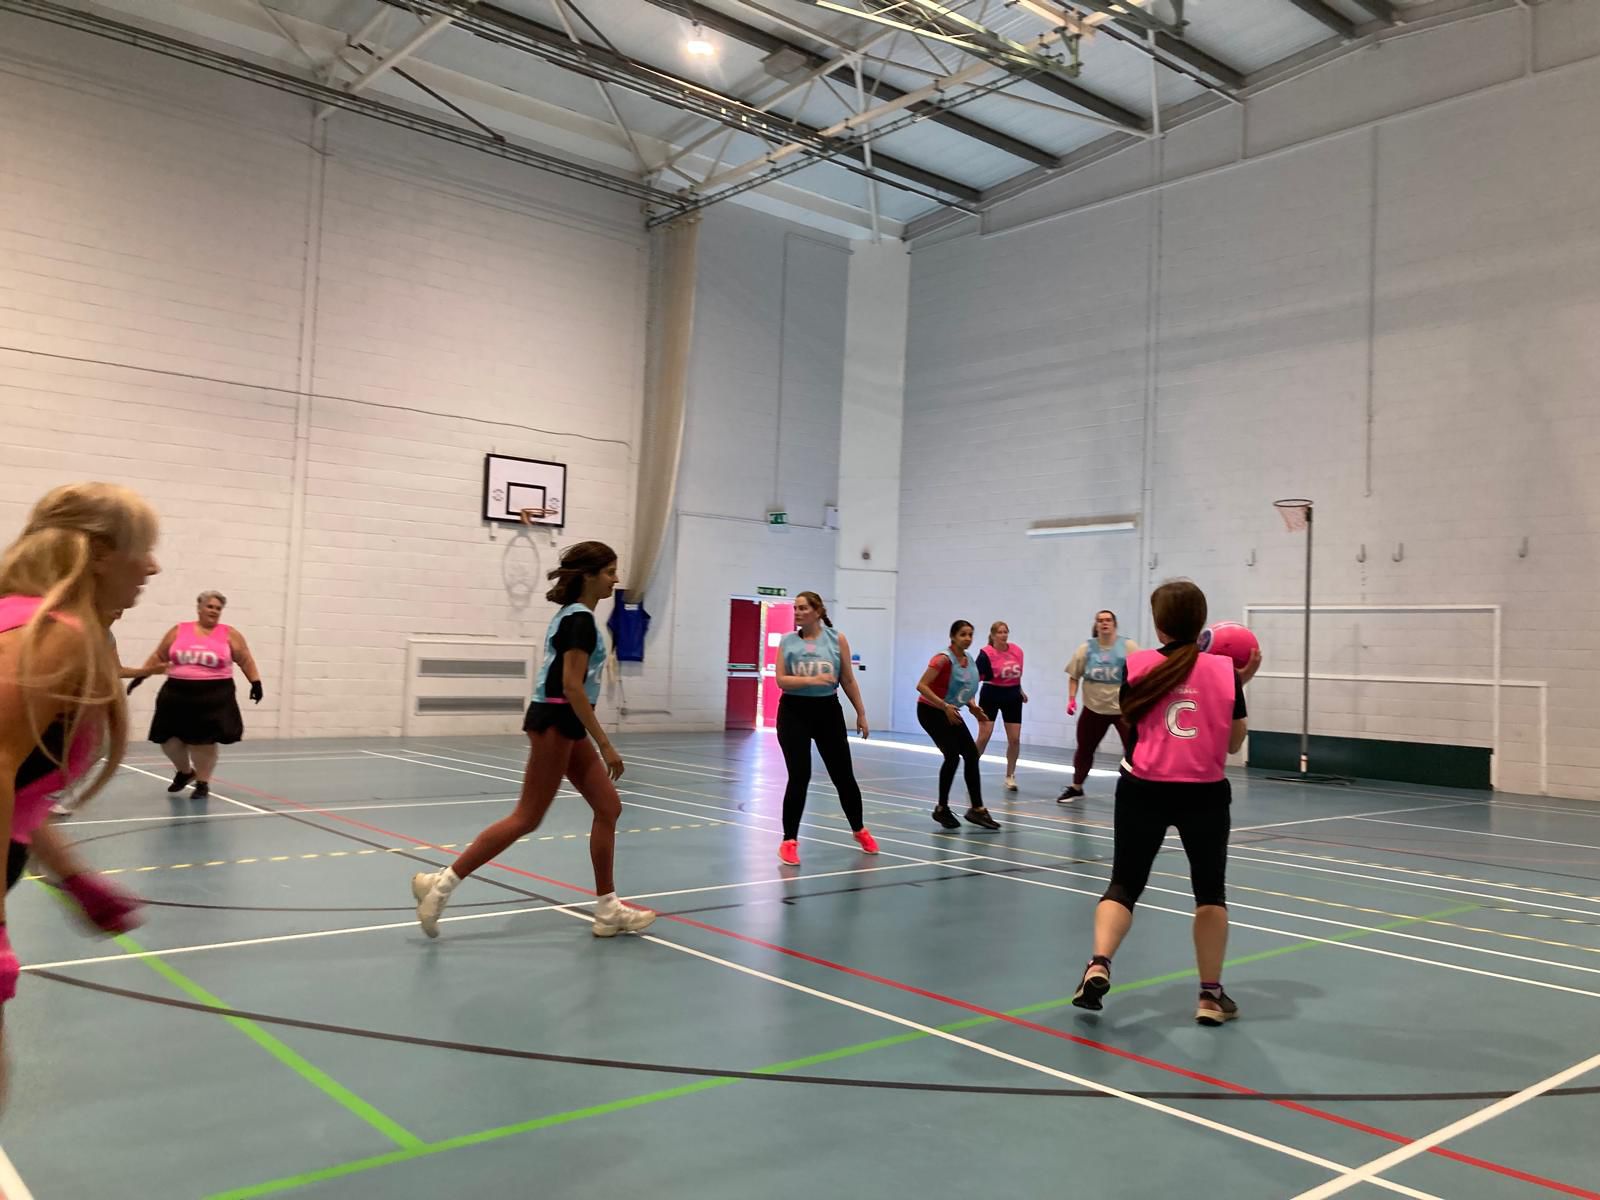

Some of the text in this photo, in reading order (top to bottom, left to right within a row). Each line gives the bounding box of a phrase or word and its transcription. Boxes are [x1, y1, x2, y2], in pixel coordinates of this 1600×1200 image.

[175, 649, 218, 668] WD
[791, 660, 834, 677] WD
[1091, 667, 1120, 681] GK
[1166, 700, 1198, 738] C
